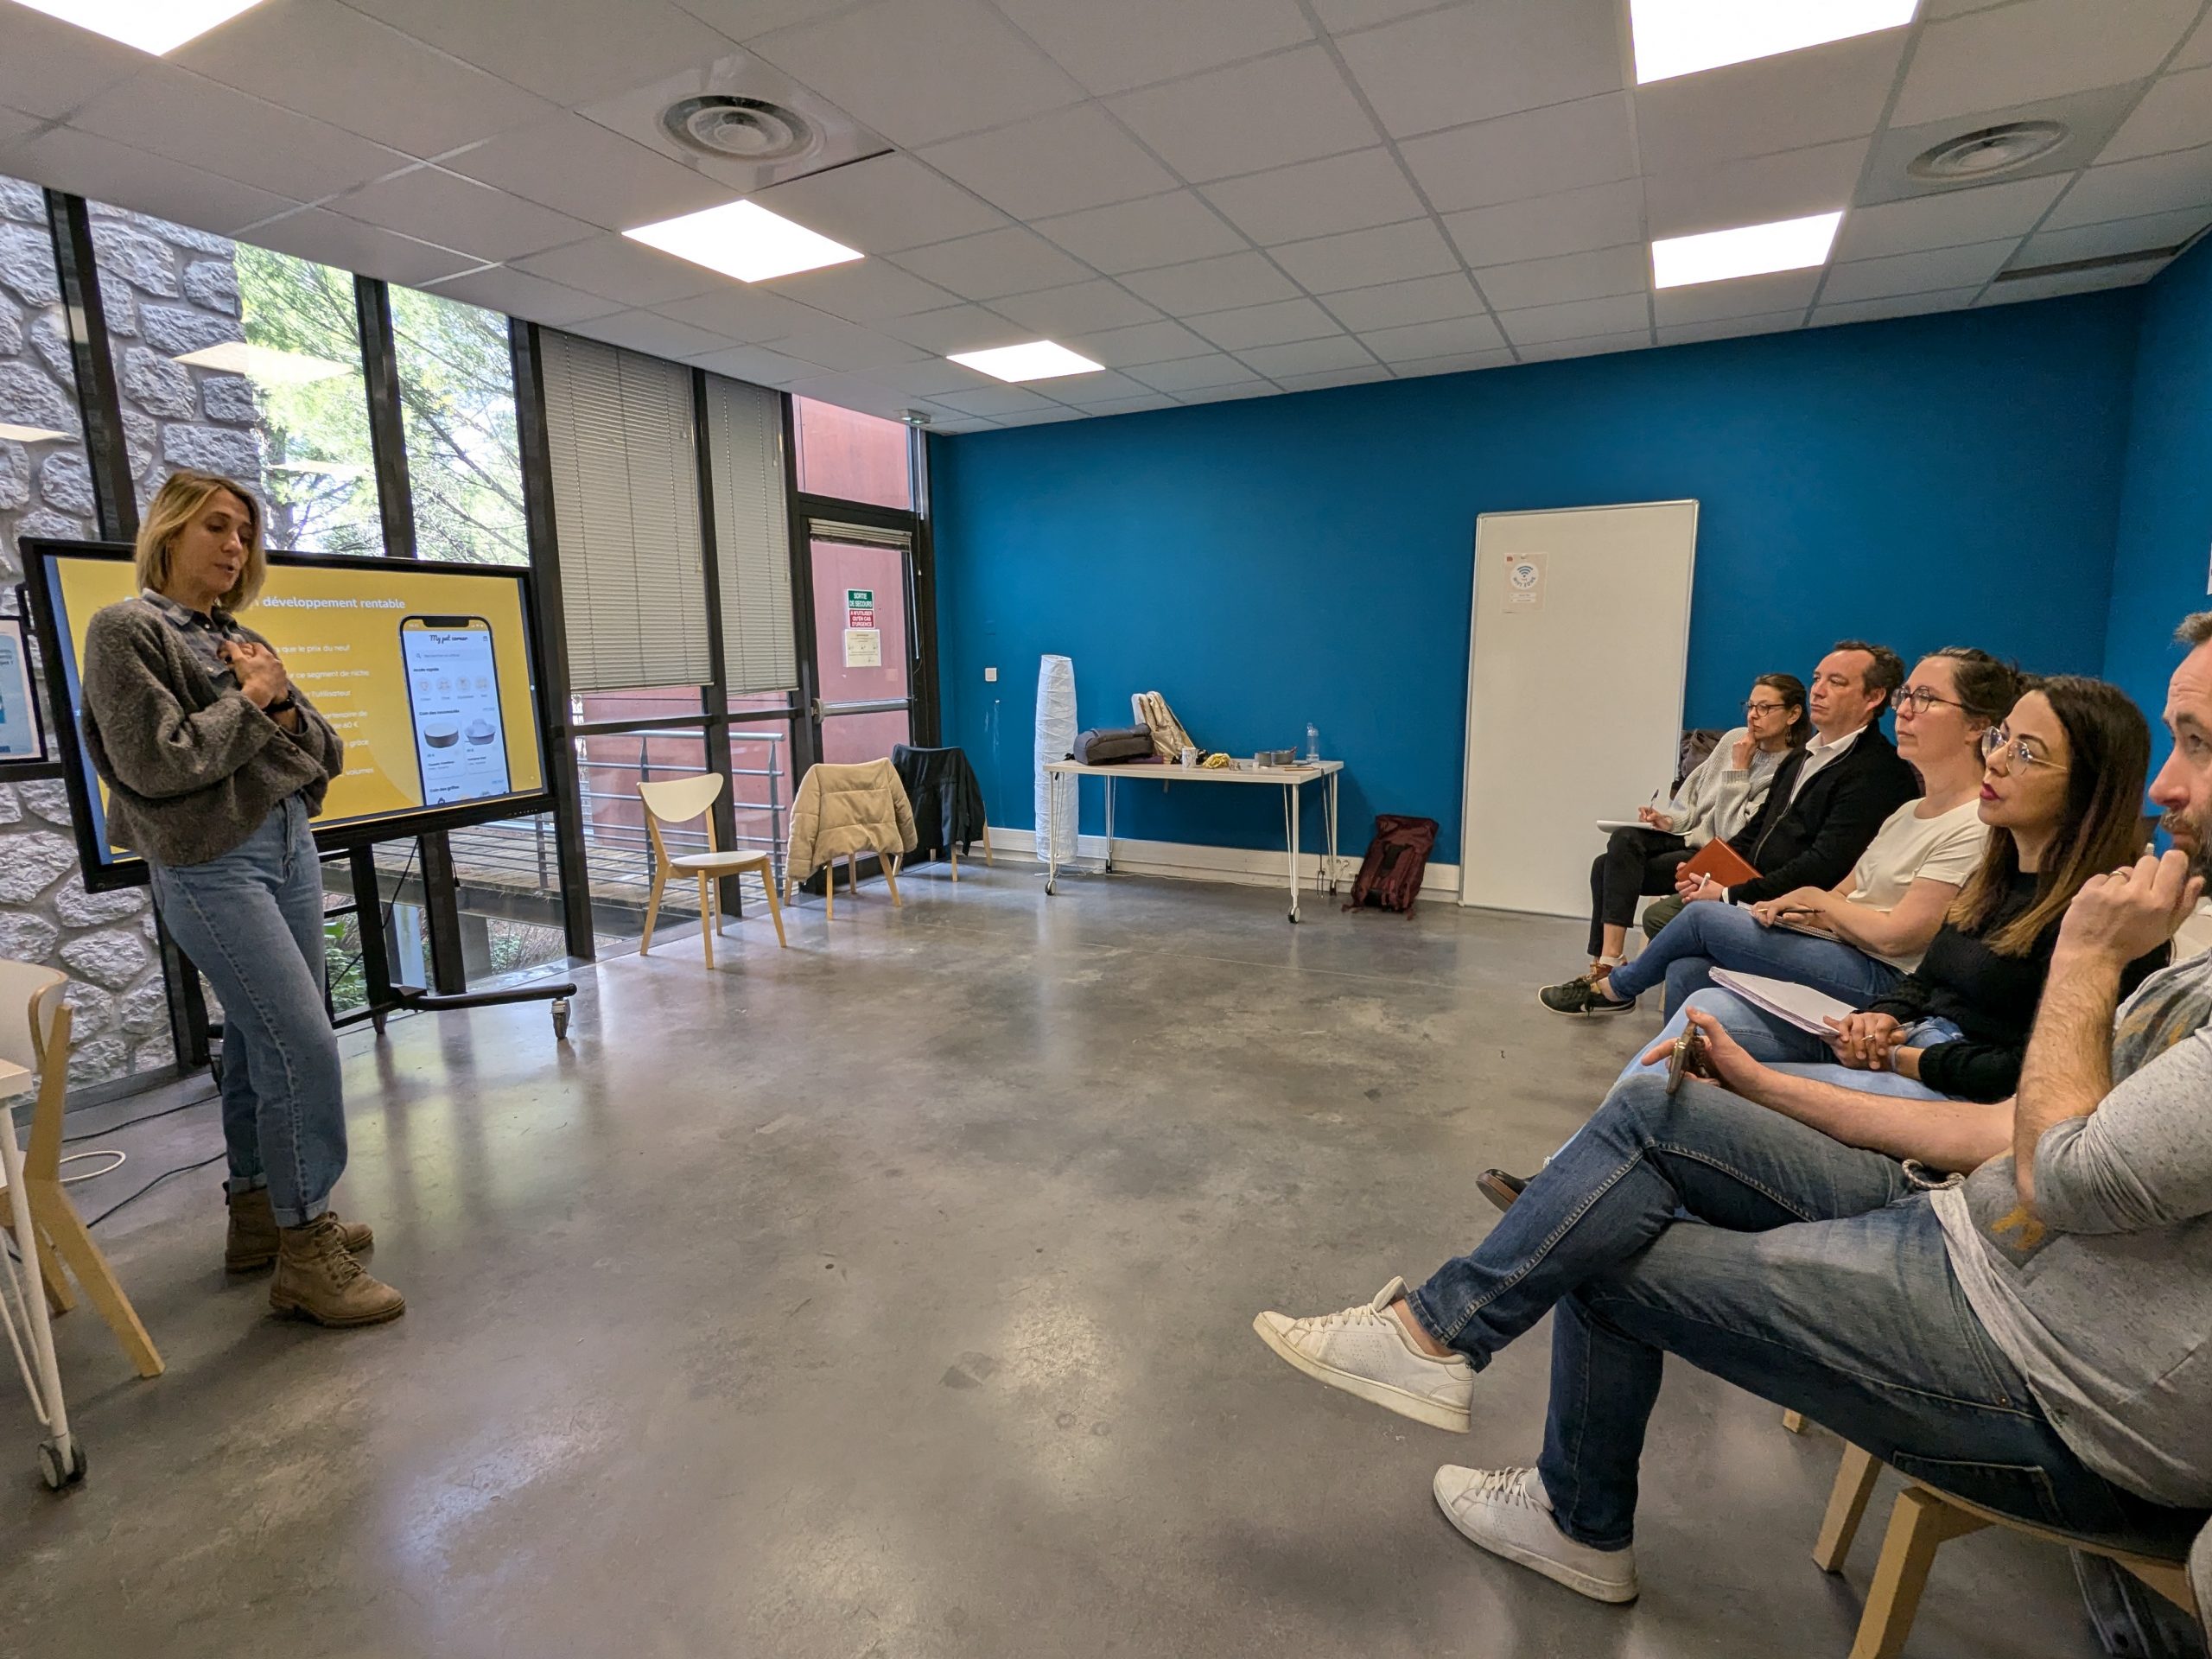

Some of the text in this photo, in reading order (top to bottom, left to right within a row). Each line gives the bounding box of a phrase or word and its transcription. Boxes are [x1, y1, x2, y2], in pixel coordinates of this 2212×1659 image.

[263, 596, 358, 609] développement
[360, 598, 406, 609] rentable
[429, 634, 441, 645] My
[442, 634, 451, 645] pet
[306, 645, 321, 653] prix
[307, 671, 339, 679] segment
